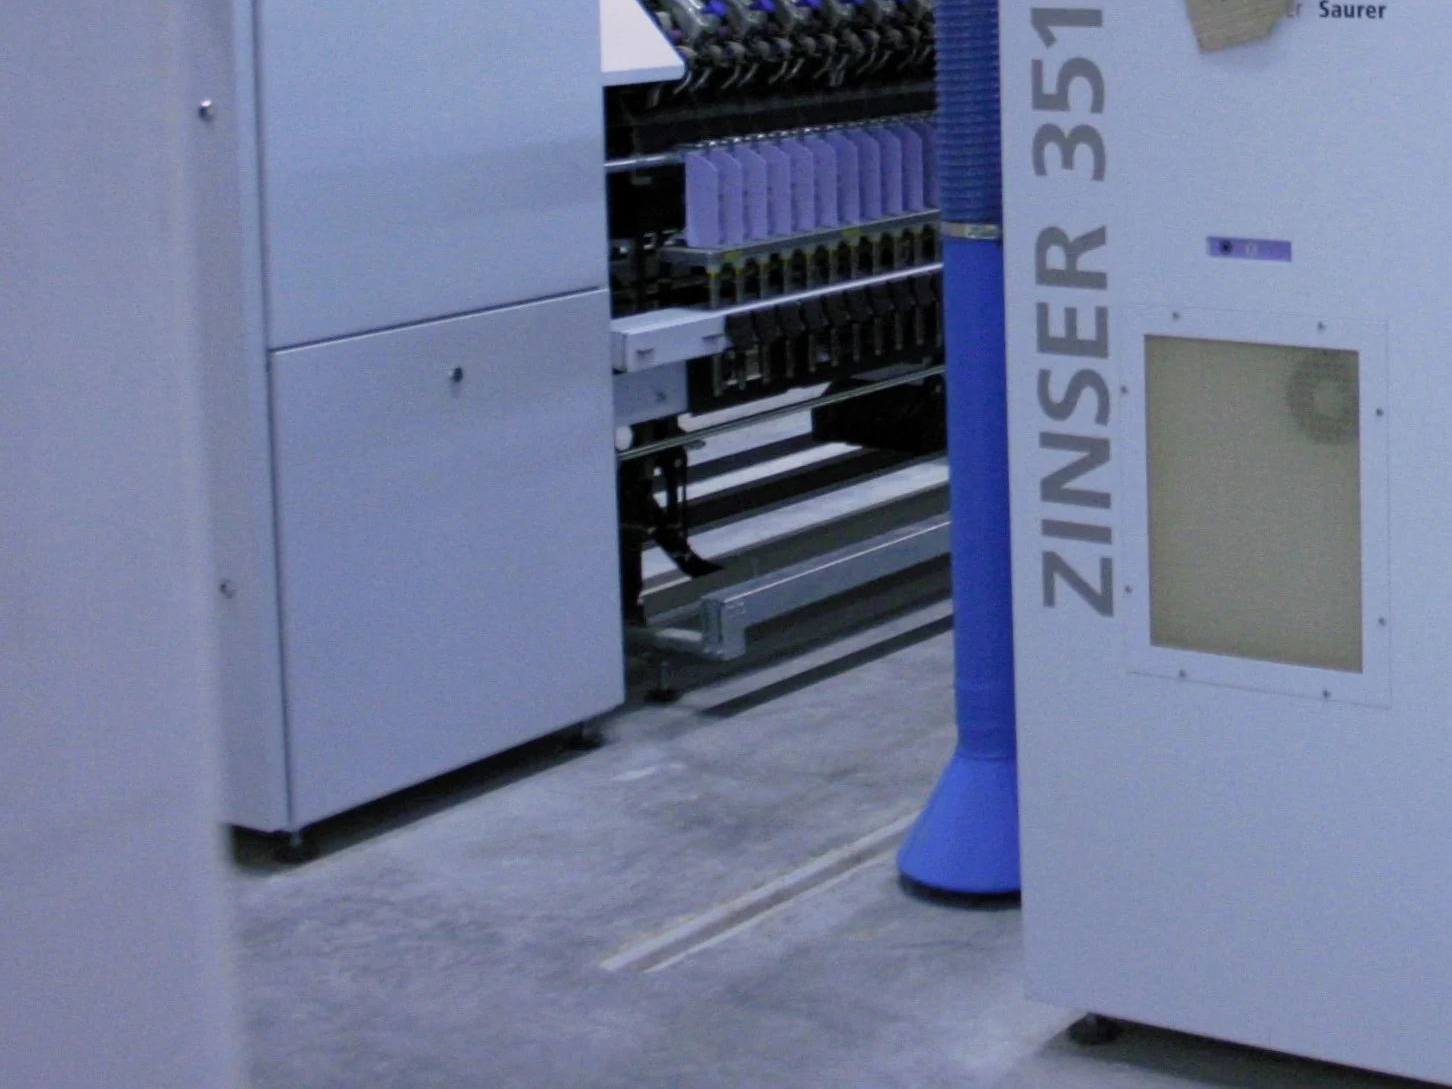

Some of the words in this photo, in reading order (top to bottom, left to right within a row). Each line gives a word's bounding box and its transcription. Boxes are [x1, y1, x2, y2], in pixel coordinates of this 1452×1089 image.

[1031, 7, 1106, 181] 351
[1319, 0, 1387, 19] Saurer
[1035, 225, 1114, 617] ZINSER
